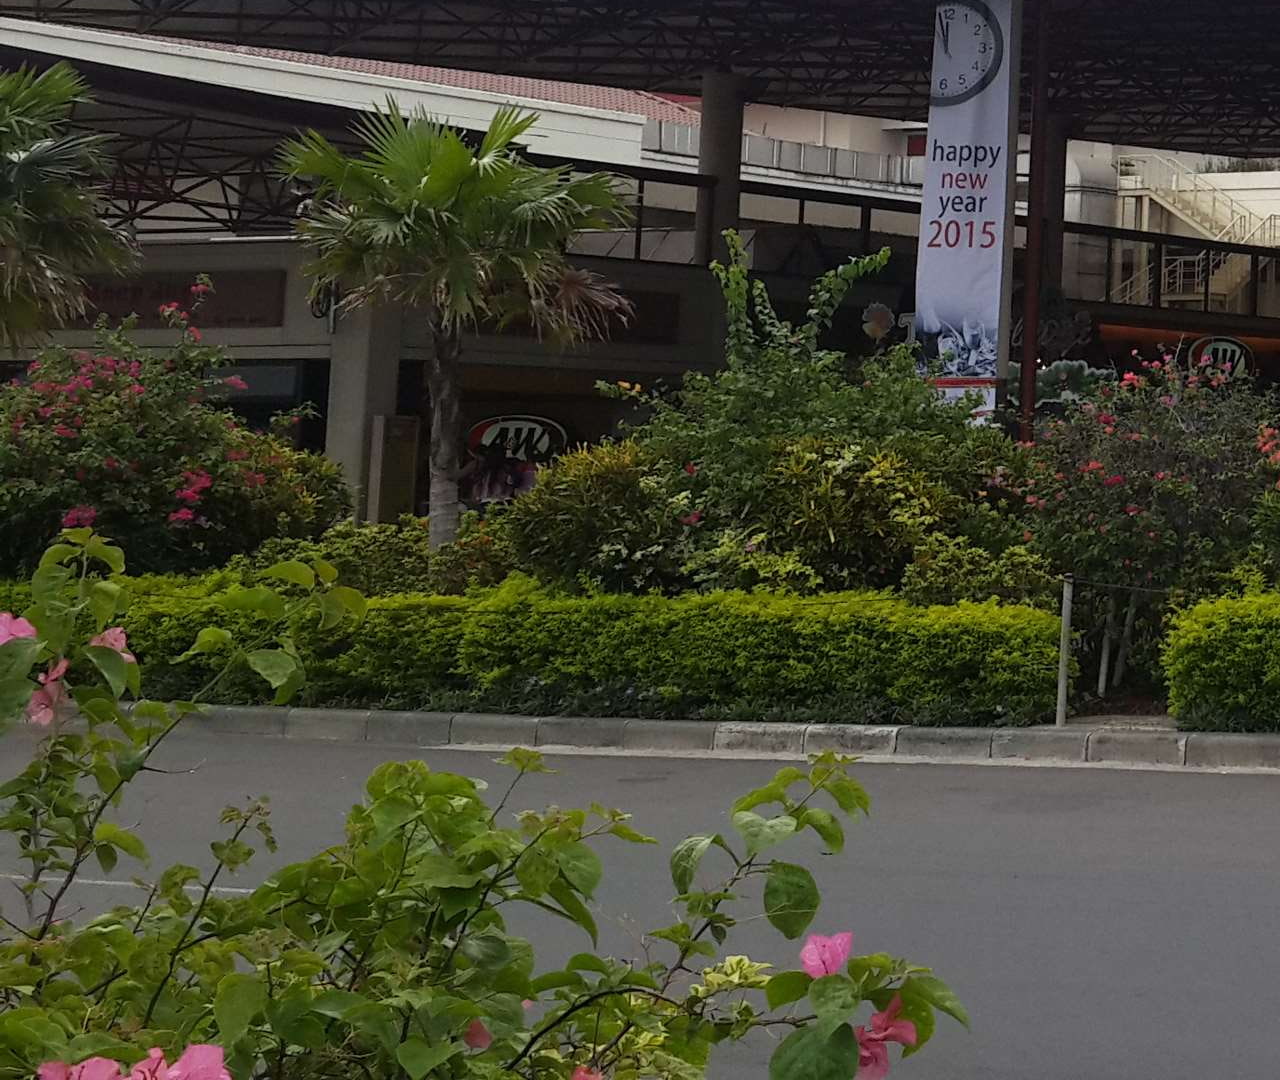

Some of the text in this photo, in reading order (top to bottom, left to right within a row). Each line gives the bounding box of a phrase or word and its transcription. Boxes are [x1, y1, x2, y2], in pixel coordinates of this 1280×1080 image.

[932, 138, 1001, 169] happy
[941, 171, 989, 190] new
[938, 195, 988, 218] year
[927, 219, 997, 249] 2015
